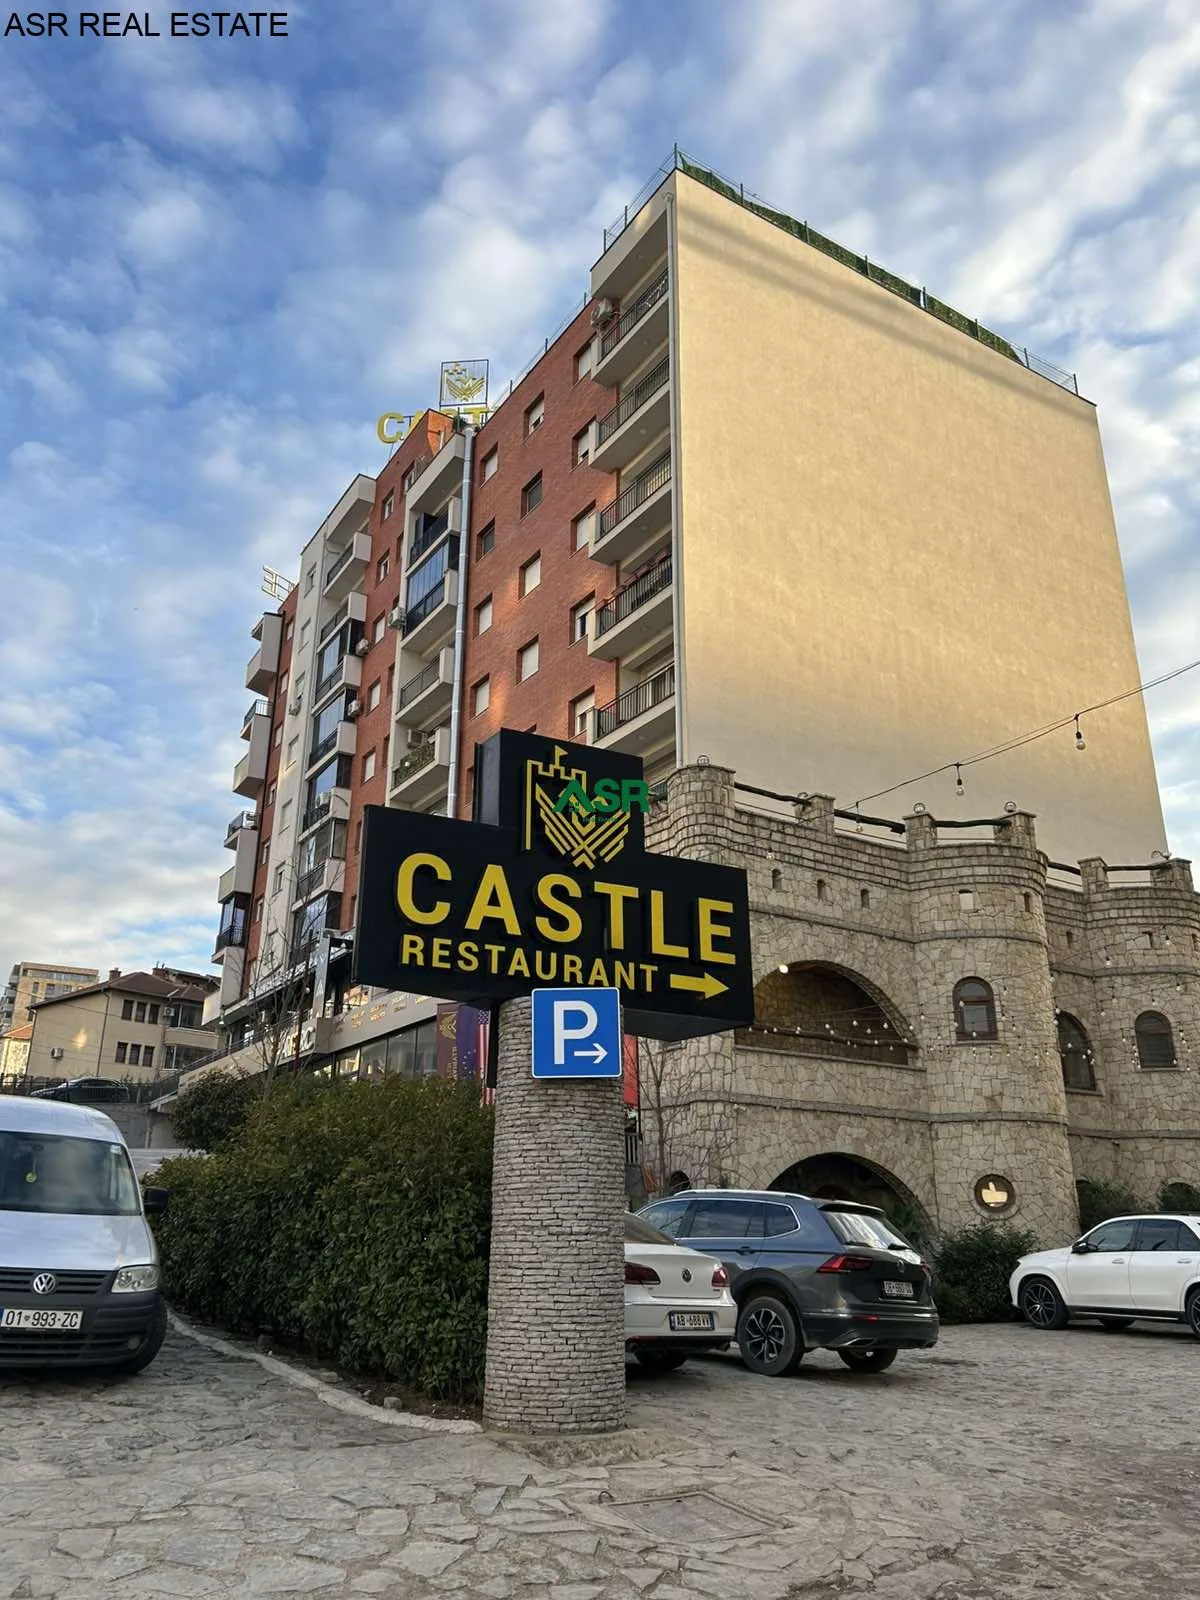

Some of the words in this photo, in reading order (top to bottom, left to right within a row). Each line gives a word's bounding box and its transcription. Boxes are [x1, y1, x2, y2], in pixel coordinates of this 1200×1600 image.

[396, 852, 737, 966] CASTLE
[401, 934, 659, 993] RESTAURANT
[553, 1000, 598, 1065] P
